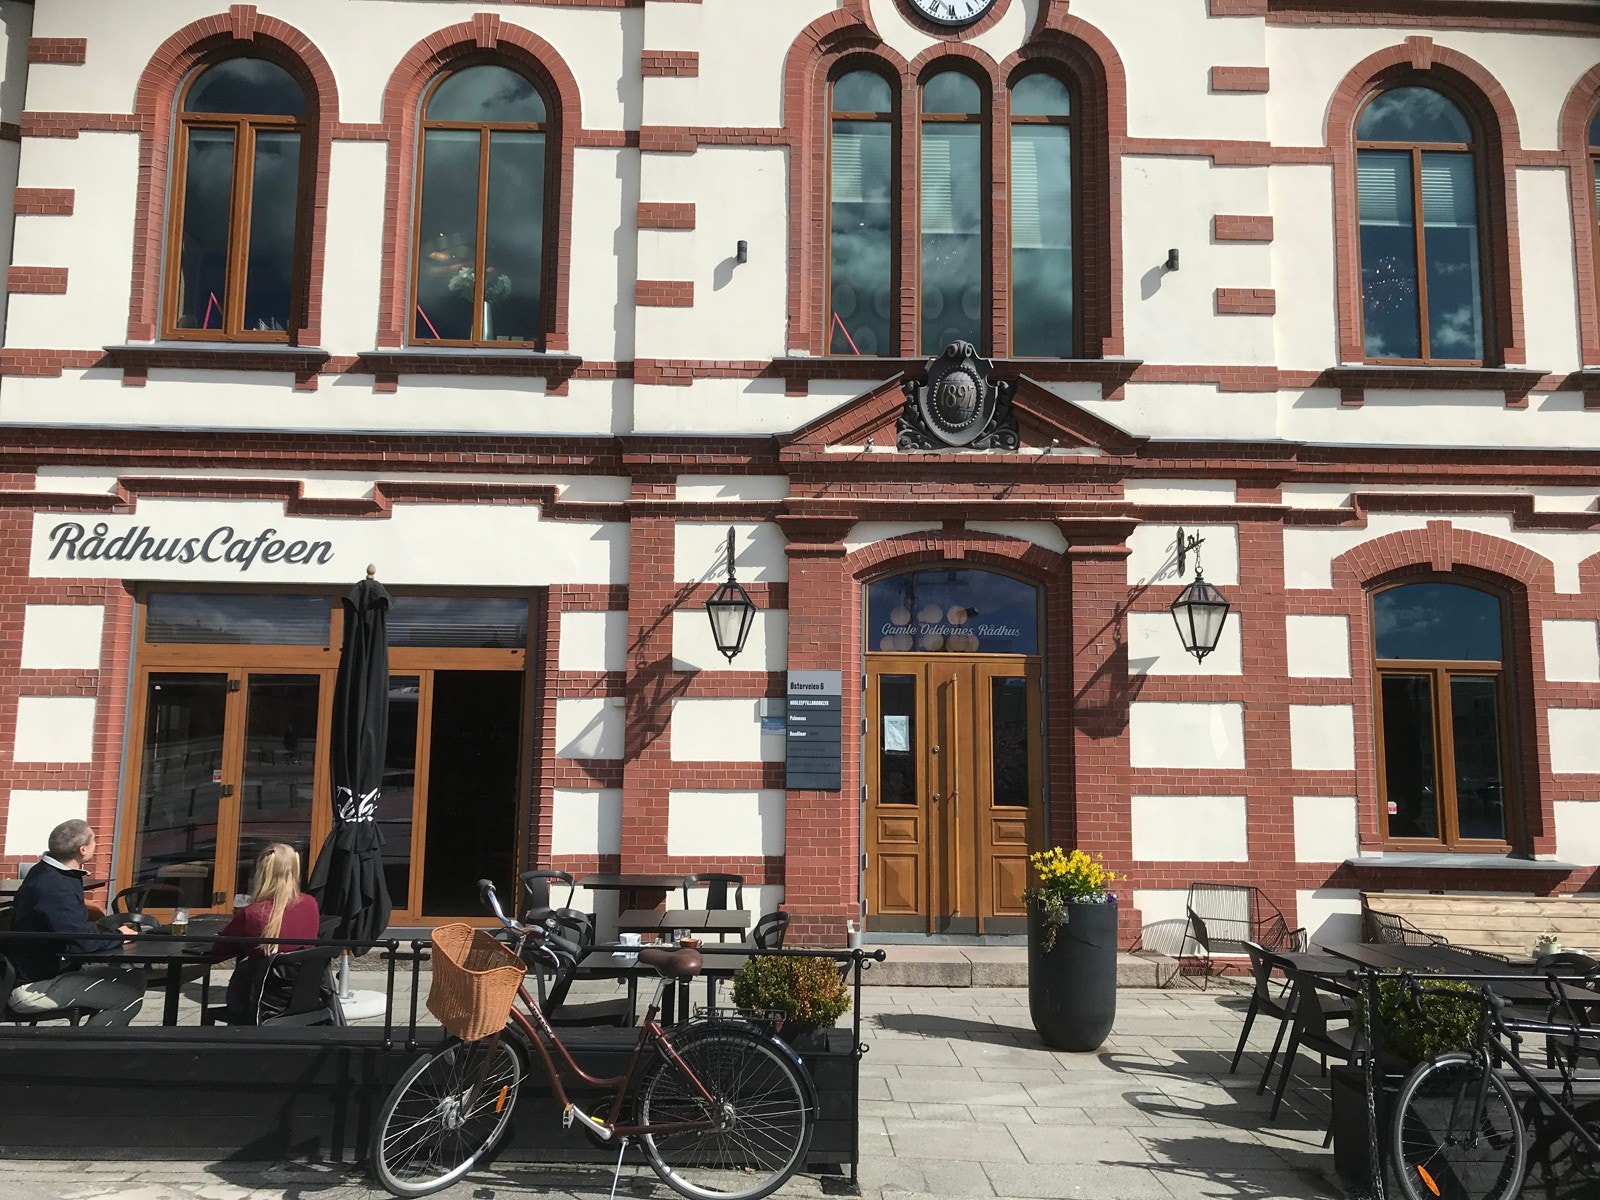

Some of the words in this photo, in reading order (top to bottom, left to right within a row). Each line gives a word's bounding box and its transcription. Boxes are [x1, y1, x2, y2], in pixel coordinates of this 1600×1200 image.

[940, 383, 975, 408] 1897
[47, 522, 334, 572] RådhusCafeen
[881, 623, 917, 636] Gamle
[920, 624, 974, 636] Oddernes
[978, 624, 1021, 637] Rådhus
